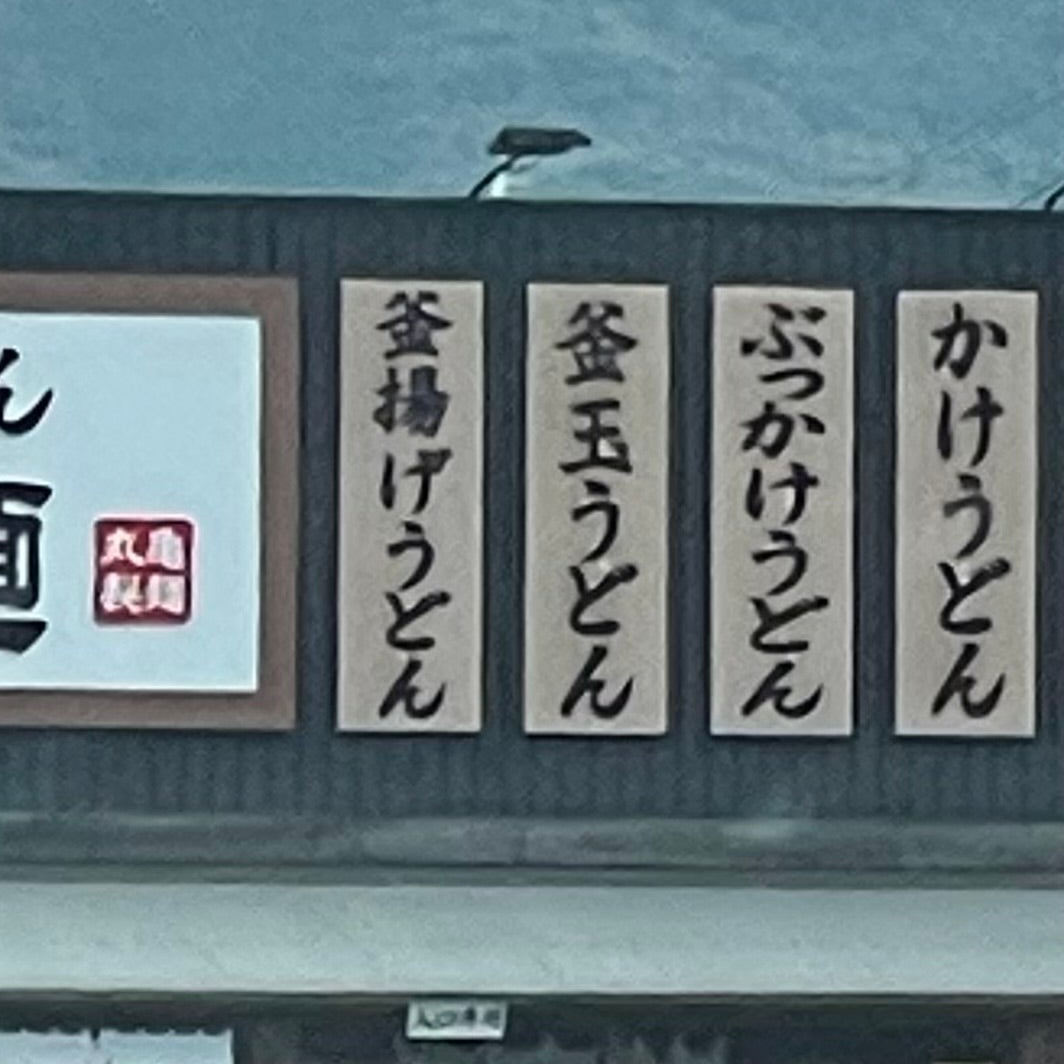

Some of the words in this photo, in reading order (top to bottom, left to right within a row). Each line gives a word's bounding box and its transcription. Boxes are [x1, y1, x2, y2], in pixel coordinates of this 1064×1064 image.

[373, 290, 454, 720] 釜揚げうどん
[554, 302, 639, 720] 釜玉うどん
[739, 303, 830, 720] ぶっかけうどん
[931, 302, 1013, 720] かけうどん
